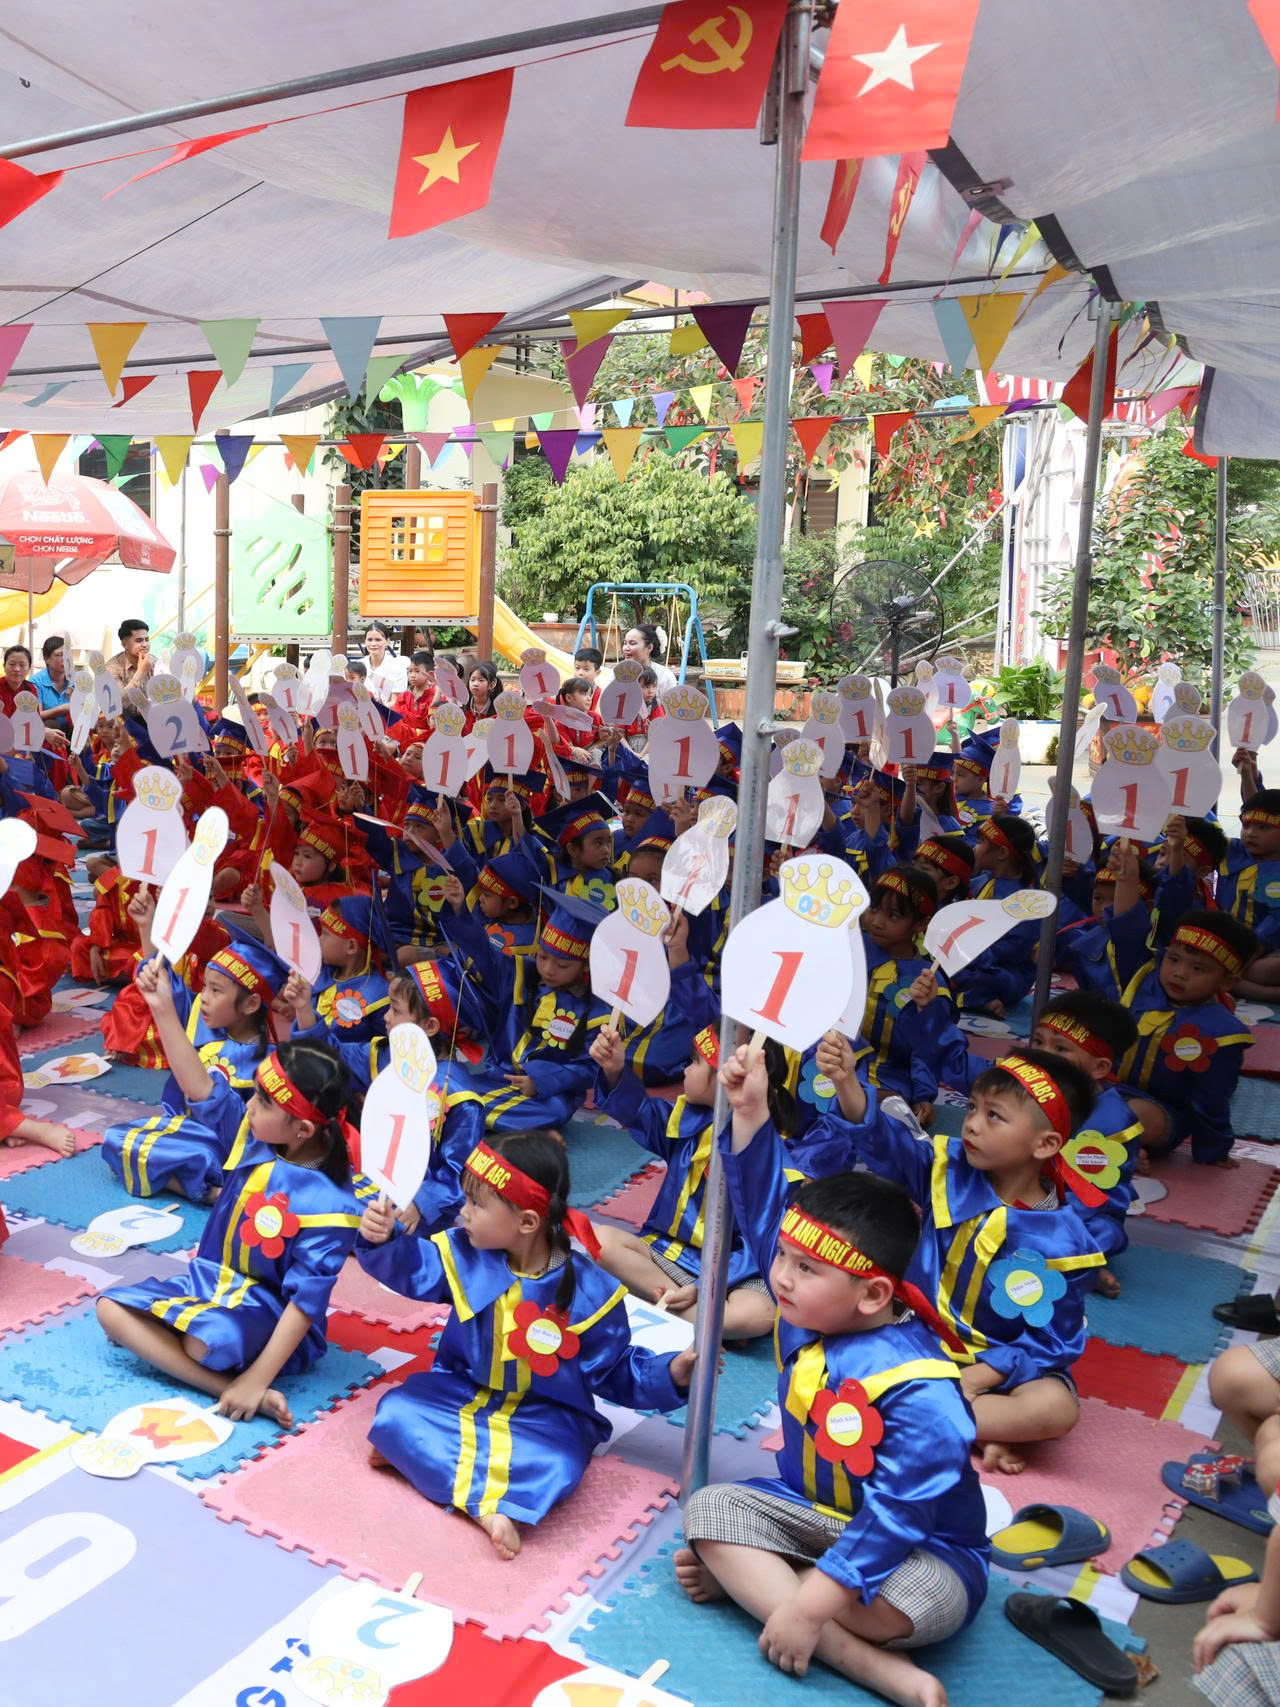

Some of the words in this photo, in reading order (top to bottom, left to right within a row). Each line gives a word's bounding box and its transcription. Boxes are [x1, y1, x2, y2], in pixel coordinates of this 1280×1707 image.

[102, 684, 117, 713] 2
[283, 688, 295, 709] 1
[447, 679, 457, 698] 1
[535, 672, 548, 694] 1
[946, 682, 955, 704] 1
[613, 692, 626, 719] 1
[1108, 693, 1124, 717] 1
[22, 722, 32, 746] 1
[165, 715, 186, 750] 2
[368, 711, 377, 735] 1
[852, 710, 870, 737] 1
[1239, 712, 1253, 743] 1
[347, 743, 359, 776] 1
[504, 734, 517, 768] 1
[672, 736, 693, 777] 1
[899, 728, 916, 758] 1
[438, 750, 450, 787] 1
[1000, 762, 1010, 794] 1
[1169, 768, 1191, 808] 1
[784, 793, 800, 836] 1
[1120, 783, 1140, 830] 1
[137, 829, 157, 876] 1
[161, 887, 190, 944] 1
[288, 922, 304, 970] 1
[937, 915, 986, 960] 1
[228, 959, 250, 977] NGỮ
[241, 970, 260, 990] ABC
[610, 949, 638, 1006] 1
[750, 952, 804, 1028] 1
[424, 983, 443, 1002] ABC
[1068, 1023, 1091, 1044] ABC
[1014, 1063, 1046, 1083] NGỮ
[1030, 1081, 1057, 1104] ABC
[377, 1114, 406, 1186] 1
[470, 1150, 496, 1177] NGỮ
[484, 1164, 513, 1190] ABC
[791, 1219, 823, 1250] ANH
[816, 1233, 853, 1265] NGỮ
[357, 1597, 424, 1650] 2
